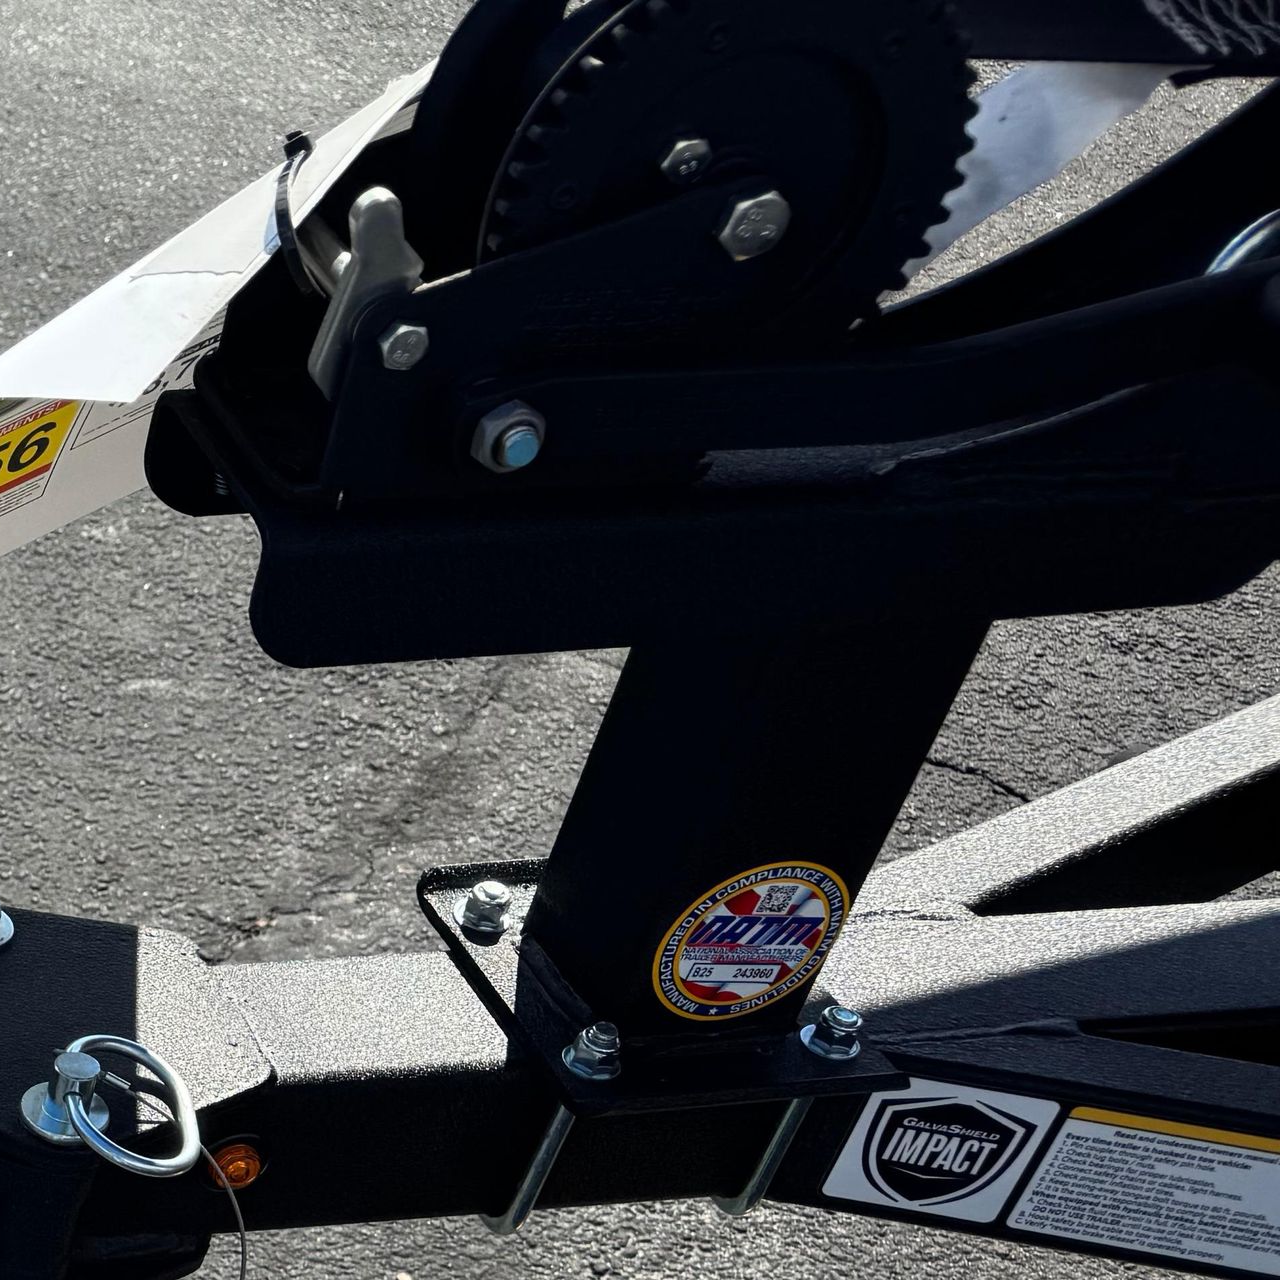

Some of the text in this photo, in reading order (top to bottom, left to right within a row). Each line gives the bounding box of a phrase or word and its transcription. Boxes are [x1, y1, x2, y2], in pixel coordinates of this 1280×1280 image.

[660, 867, 843, 1014] MANUFACTURED IN COMPLIANCE WITH NATM GUIDELINES
[682, 947, 728, 955] NATIONAL
[796, 948, 809, 956] OF
[692, 967, 774, 979] B25 243960
[881, 1127, 999, 1175] IMPACT
[1065, 1133, 1091, 1142] Every
[1092, 1137, 1113, 1145] time
[1114, 1141, 1141, 1150] trailer
[1152, 1148, 1186, 1158] hooked
[1085, 1145, 1117, 1155] coupler
[1118, 1150, 1153, 1161] through
[1154, 1157, 1178, 1165] safety
[1157, 1138, 1209, 1151] understand
[1065, 1149, 1092, 1157] Check
[1108, 1156, 1129, 1164] bolts
[1053, 1170, 1079, 1179] Check
[1078, 1176, 1108, 1185] proper
[1057, 1163, 1093, 1174] Connect
[1093, 1170, 1118, 1179] safety
[1119, 1174, 1146, 1183] chains
[1188, 1187, 1208, 1195] light
[1061, 1156, 1087, 1165] Check
[1088, 1161, 1124, 1172] bearings
[1139, 1171, 1168, 1180] proper
[1048, 1177, 1071, 1186] Keep
[1071, 1181, 1120, 1195] swing-away
[1121, 1190, 1151, 1201] tongue
[1171, 1199, 1199, 1209] torque
[1031, 1190, 1057, 1198] When
[1057, 1195, 1100, 1207] equipped
[1122, 1207, 1162, 1218] hydraulic
[1198, 1220, 1227, 1229] before
[1037, 1199, 1063, 1207] Check
[1064, 1203, 1087, 1211] brake
[1108, 1196, 1165, 1211] responsibility
[1177, 1208, 1207, 1218] comply
[1028, 1212, 1051, 1220] Hook
[1051, 1217, 1076, 1226] safety
[1077, 1221, 1100, 1229] brake
[1101, 1226, 1123, 1234] cable
[1086, 1215, 1121, 1226] TRAILER
[1023, 1219, 1048, 1228] Verify
[1082, 1230, 1104, 1238] brake
[1147, 1242, 1187, 1254] operating
